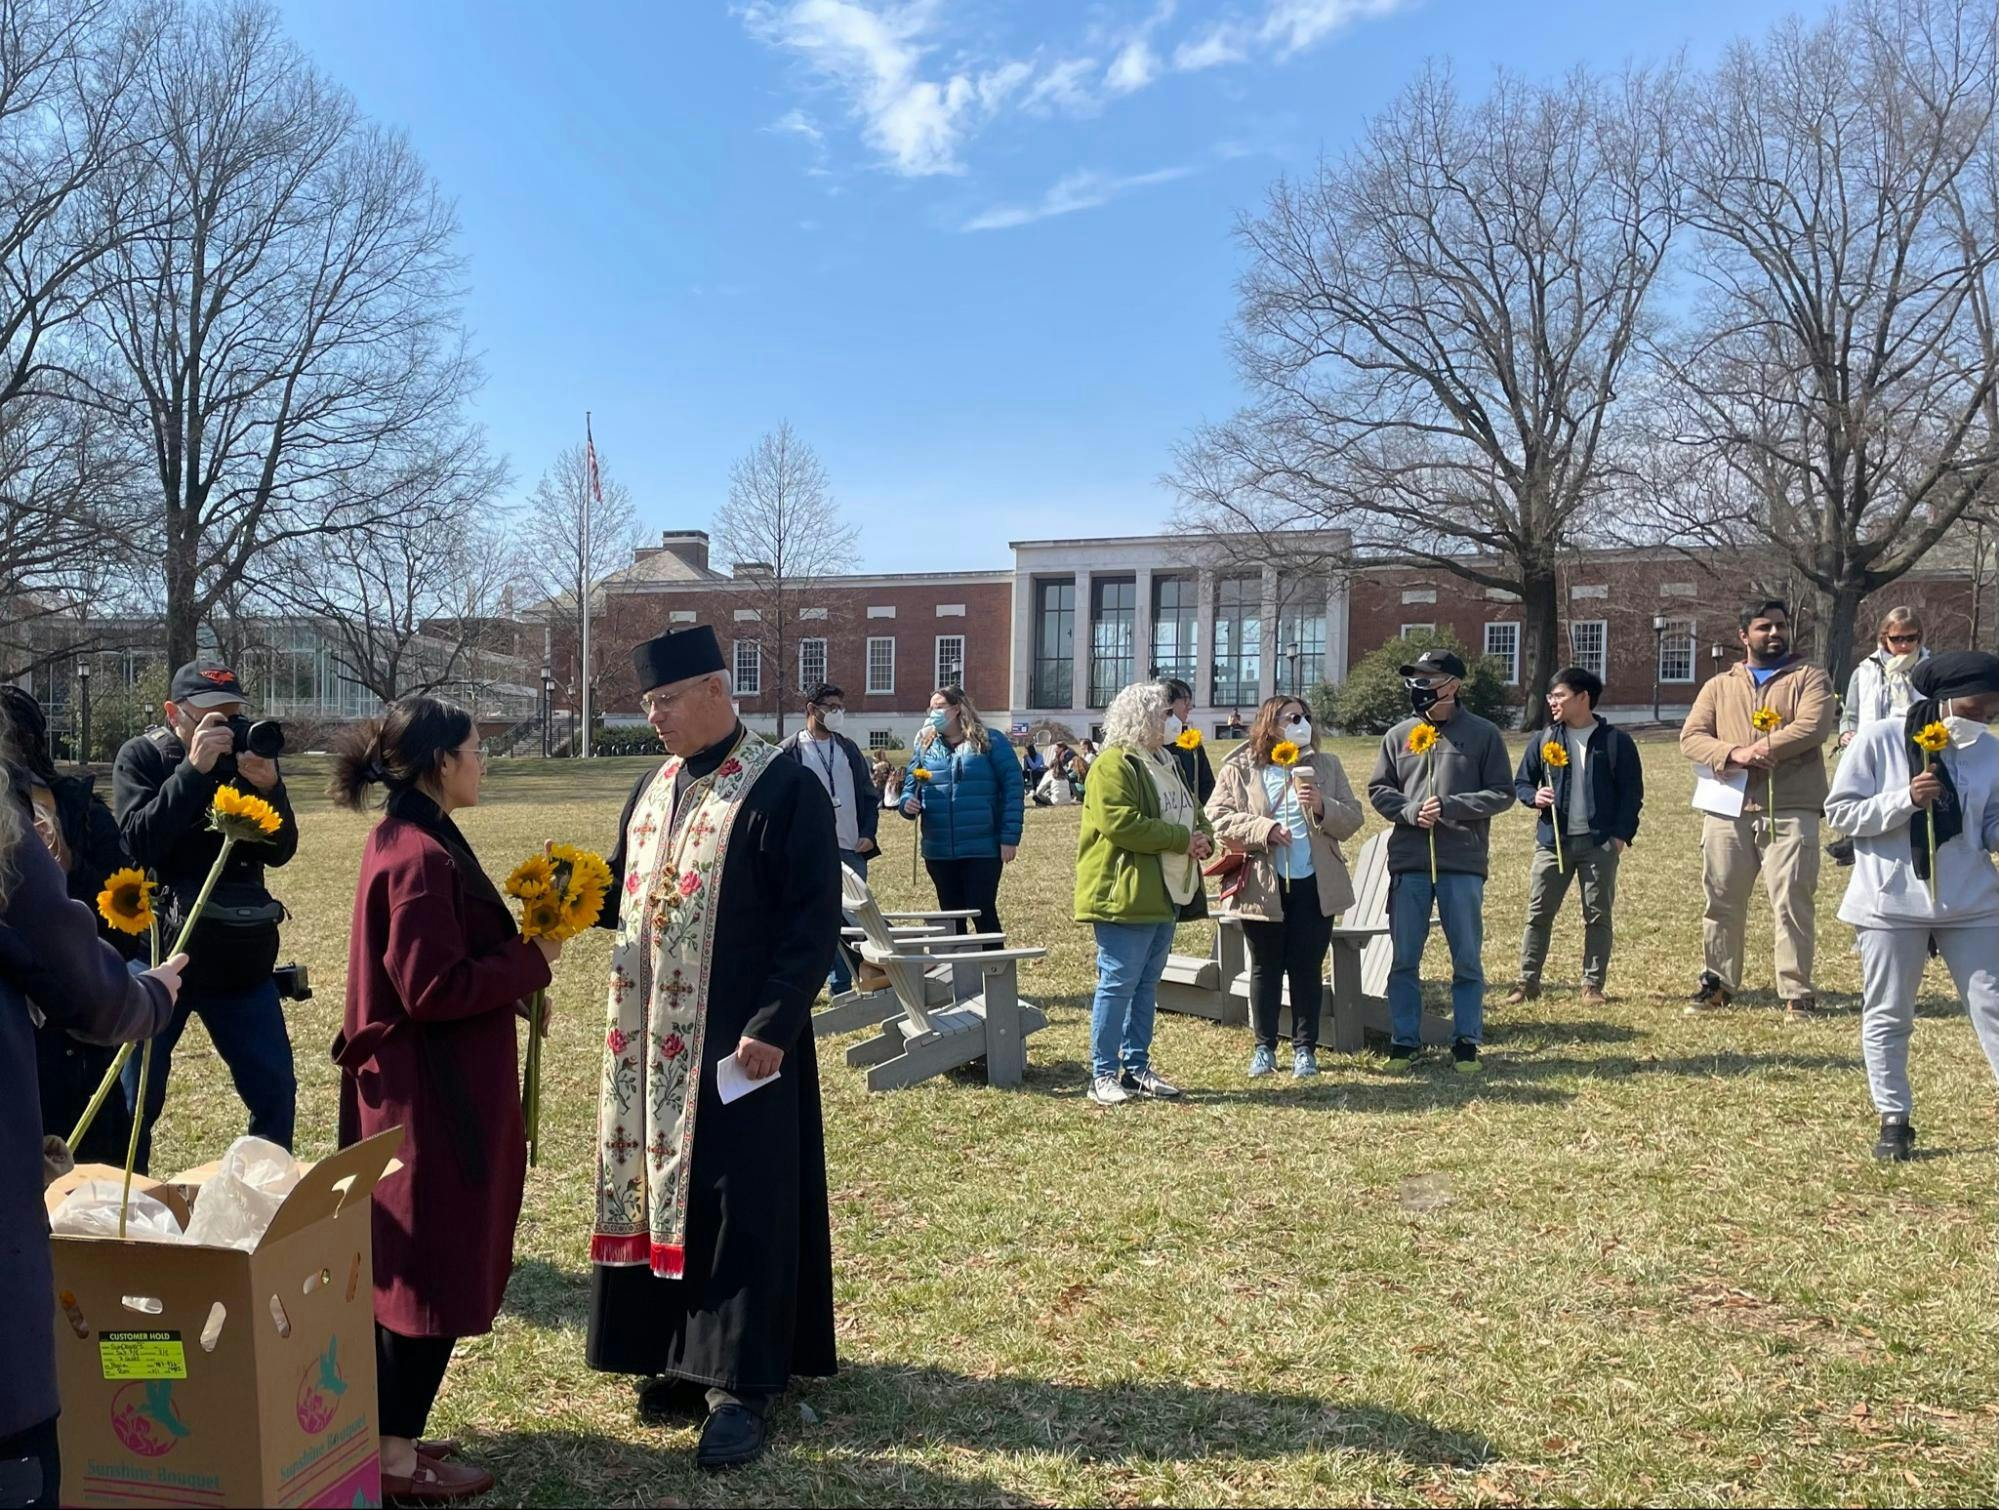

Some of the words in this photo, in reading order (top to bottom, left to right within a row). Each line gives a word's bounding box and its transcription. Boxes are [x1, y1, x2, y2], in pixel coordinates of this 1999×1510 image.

[109, 1332, 148, 1341] CUSTOMER
[149, 1332, 170, 1340] HOLD
[87, 1458, 149, 1481] Sunshine
[158, 1465, 220, 1489] Bouquet
